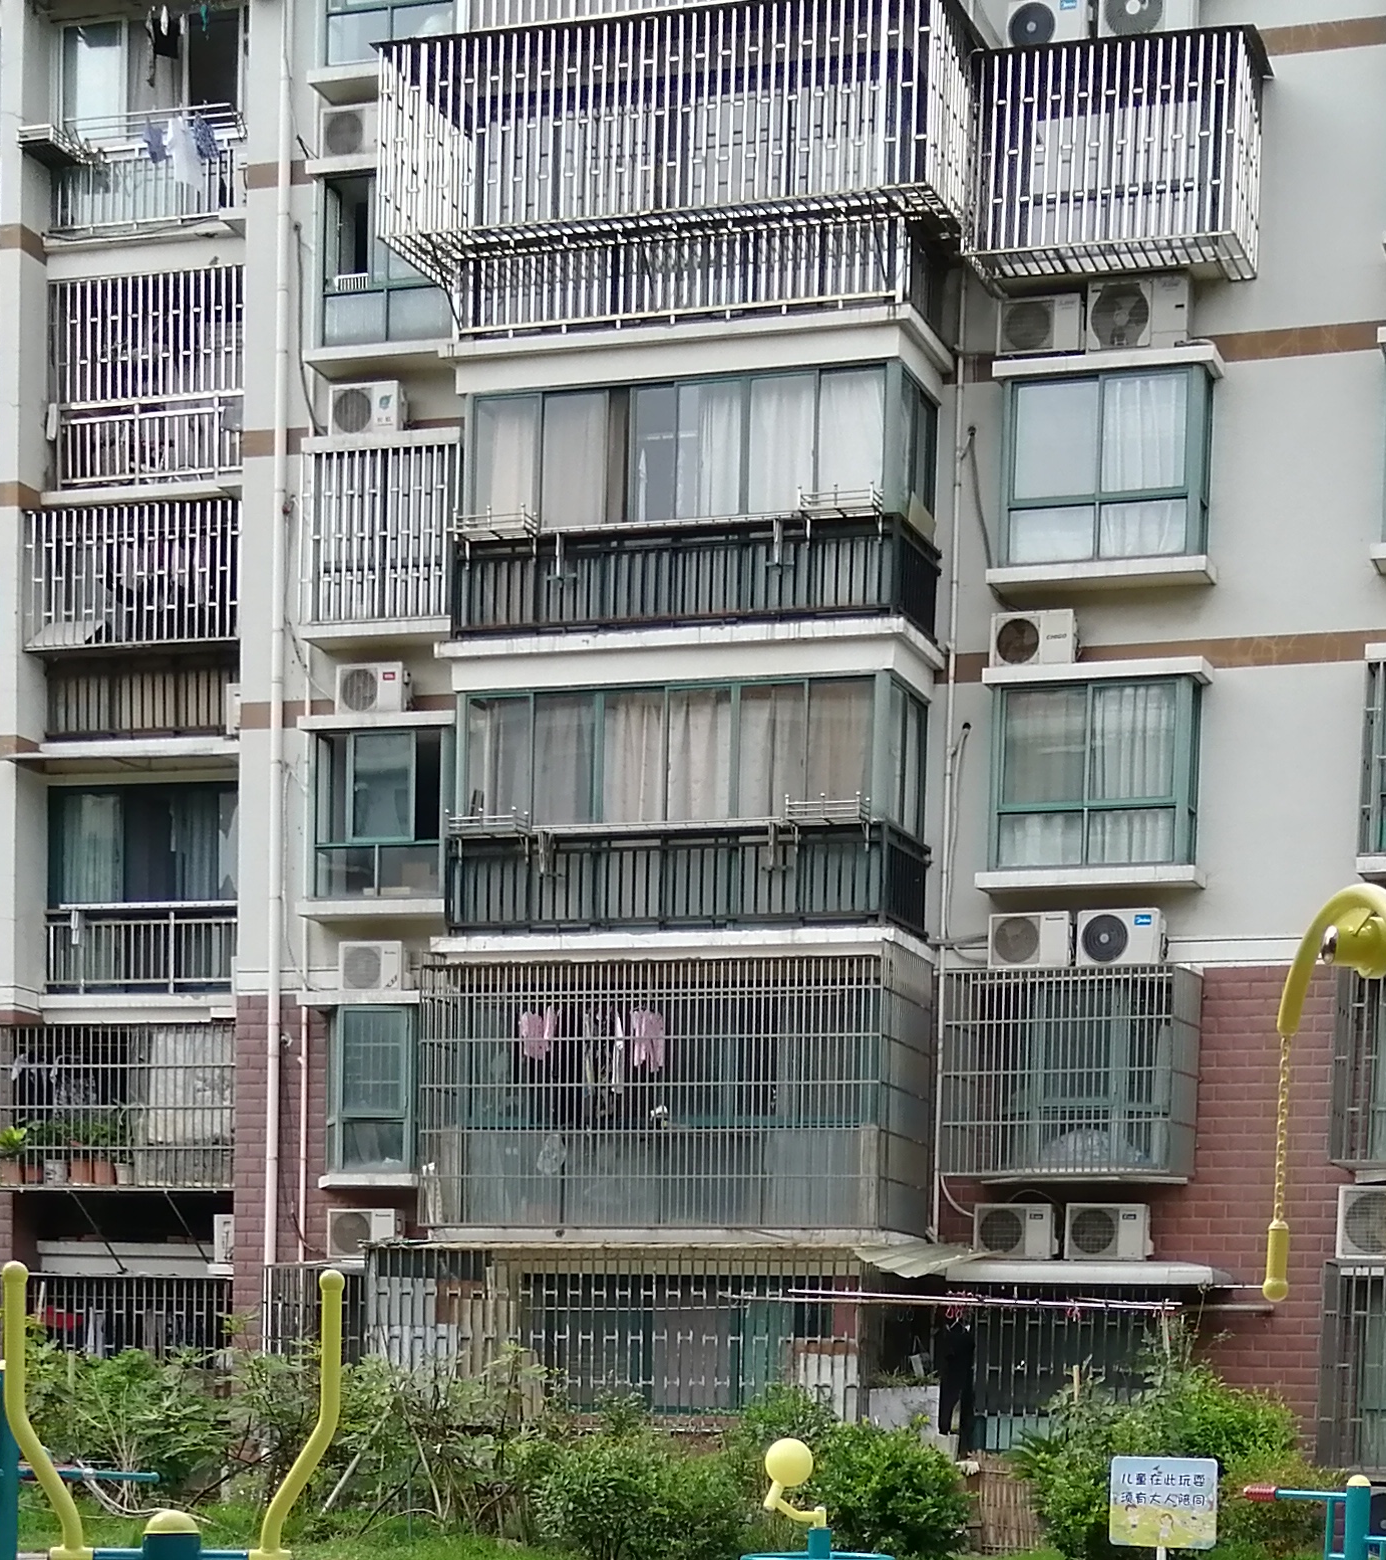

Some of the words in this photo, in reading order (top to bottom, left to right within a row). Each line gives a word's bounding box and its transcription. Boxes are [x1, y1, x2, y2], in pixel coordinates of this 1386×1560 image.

[1121, 1473, 1205, 1487] 儿童在此玩耍
[1120, 1493, 1205, 1506] 须有大人陪同
